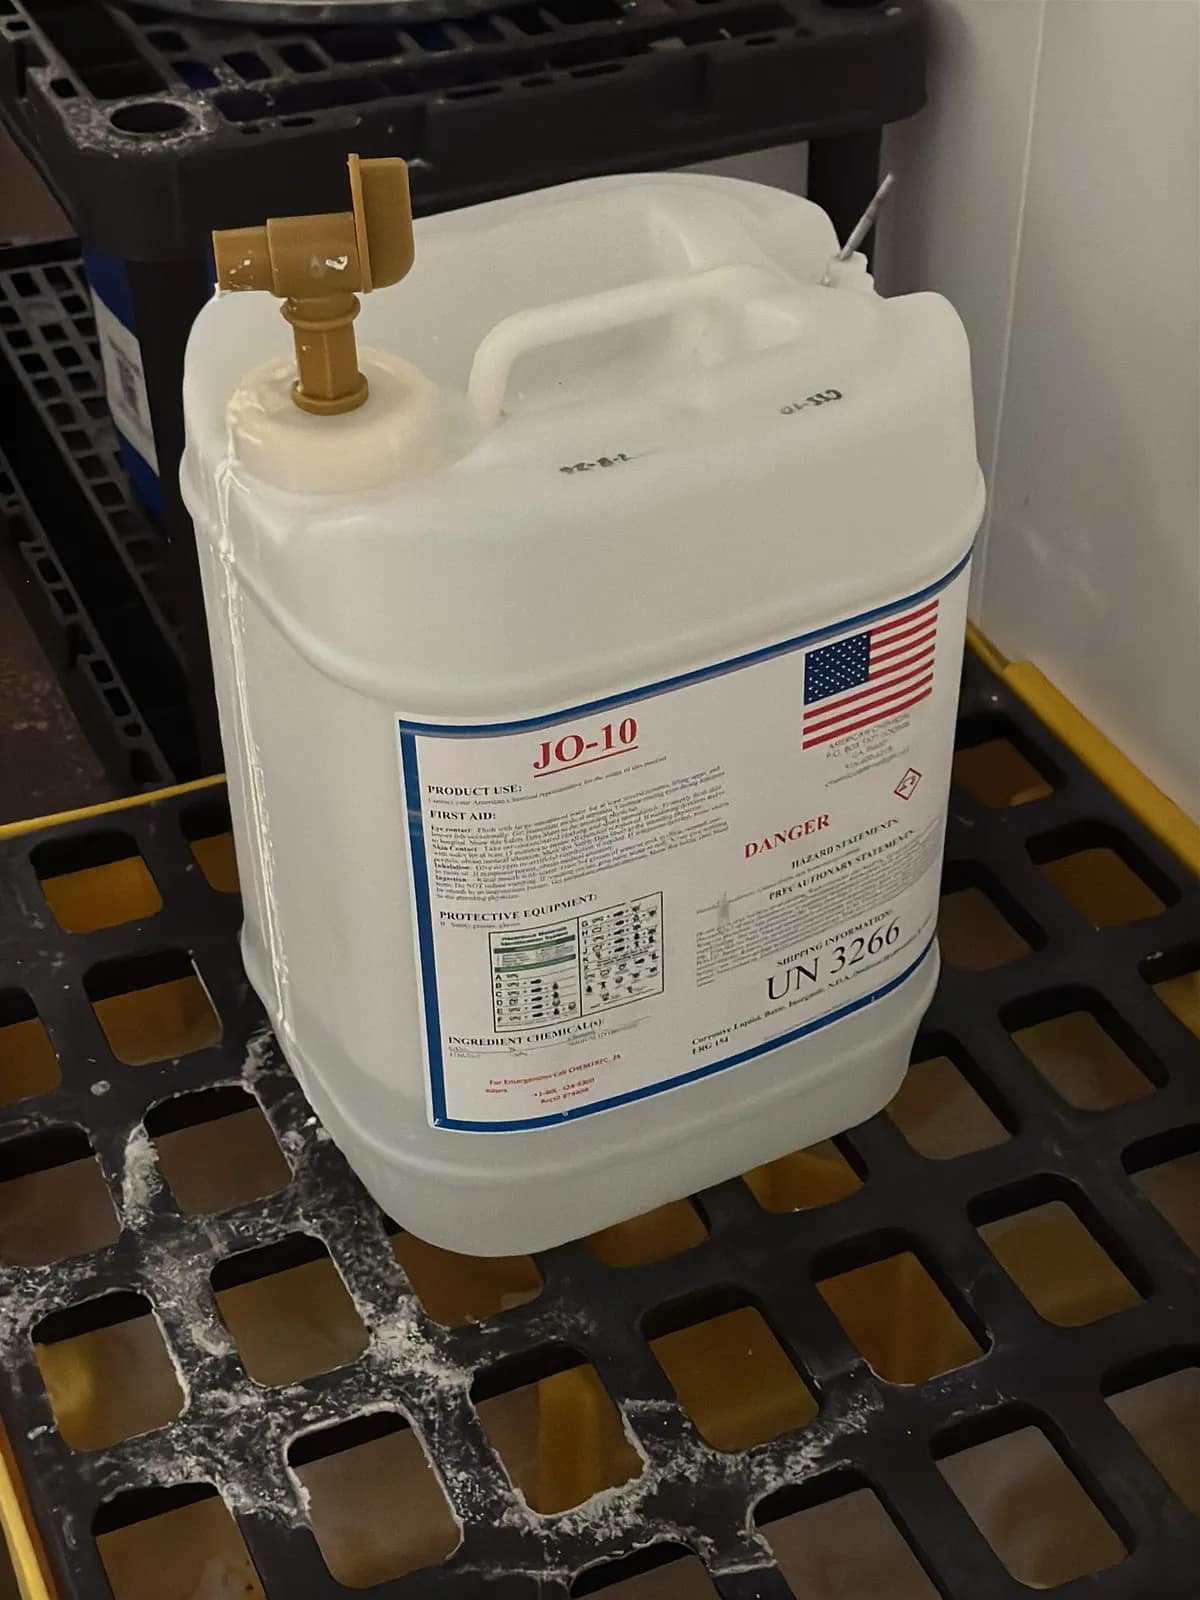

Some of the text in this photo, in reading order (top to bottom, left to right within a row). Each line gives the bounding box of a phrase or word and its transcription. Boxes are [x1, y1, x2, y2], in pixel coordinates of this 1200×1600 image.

[533, 717, 638, 771] JO-10
[428, 783, 523, 797] PRODUCT USE:
[430, 809, 496, 821] FIRST AID:
[743, 814, 831, 859] DANGER
[791, 817, 900, 870] HAZARD STATEMENTS
[769, 856, 854, 901] PRECAUTIONARY
[854, 829, 917, 868] STATEMENTS
[440, 892, 598, 922] PROTECTIVE EQUIPMENT:
[767, 957, 820, 1001] UN
[830, 915, 900, 975] 3266
[777, 942, 823, 967] SHIPPING
[449, 1035, 523, 1046] INGREDIENT
